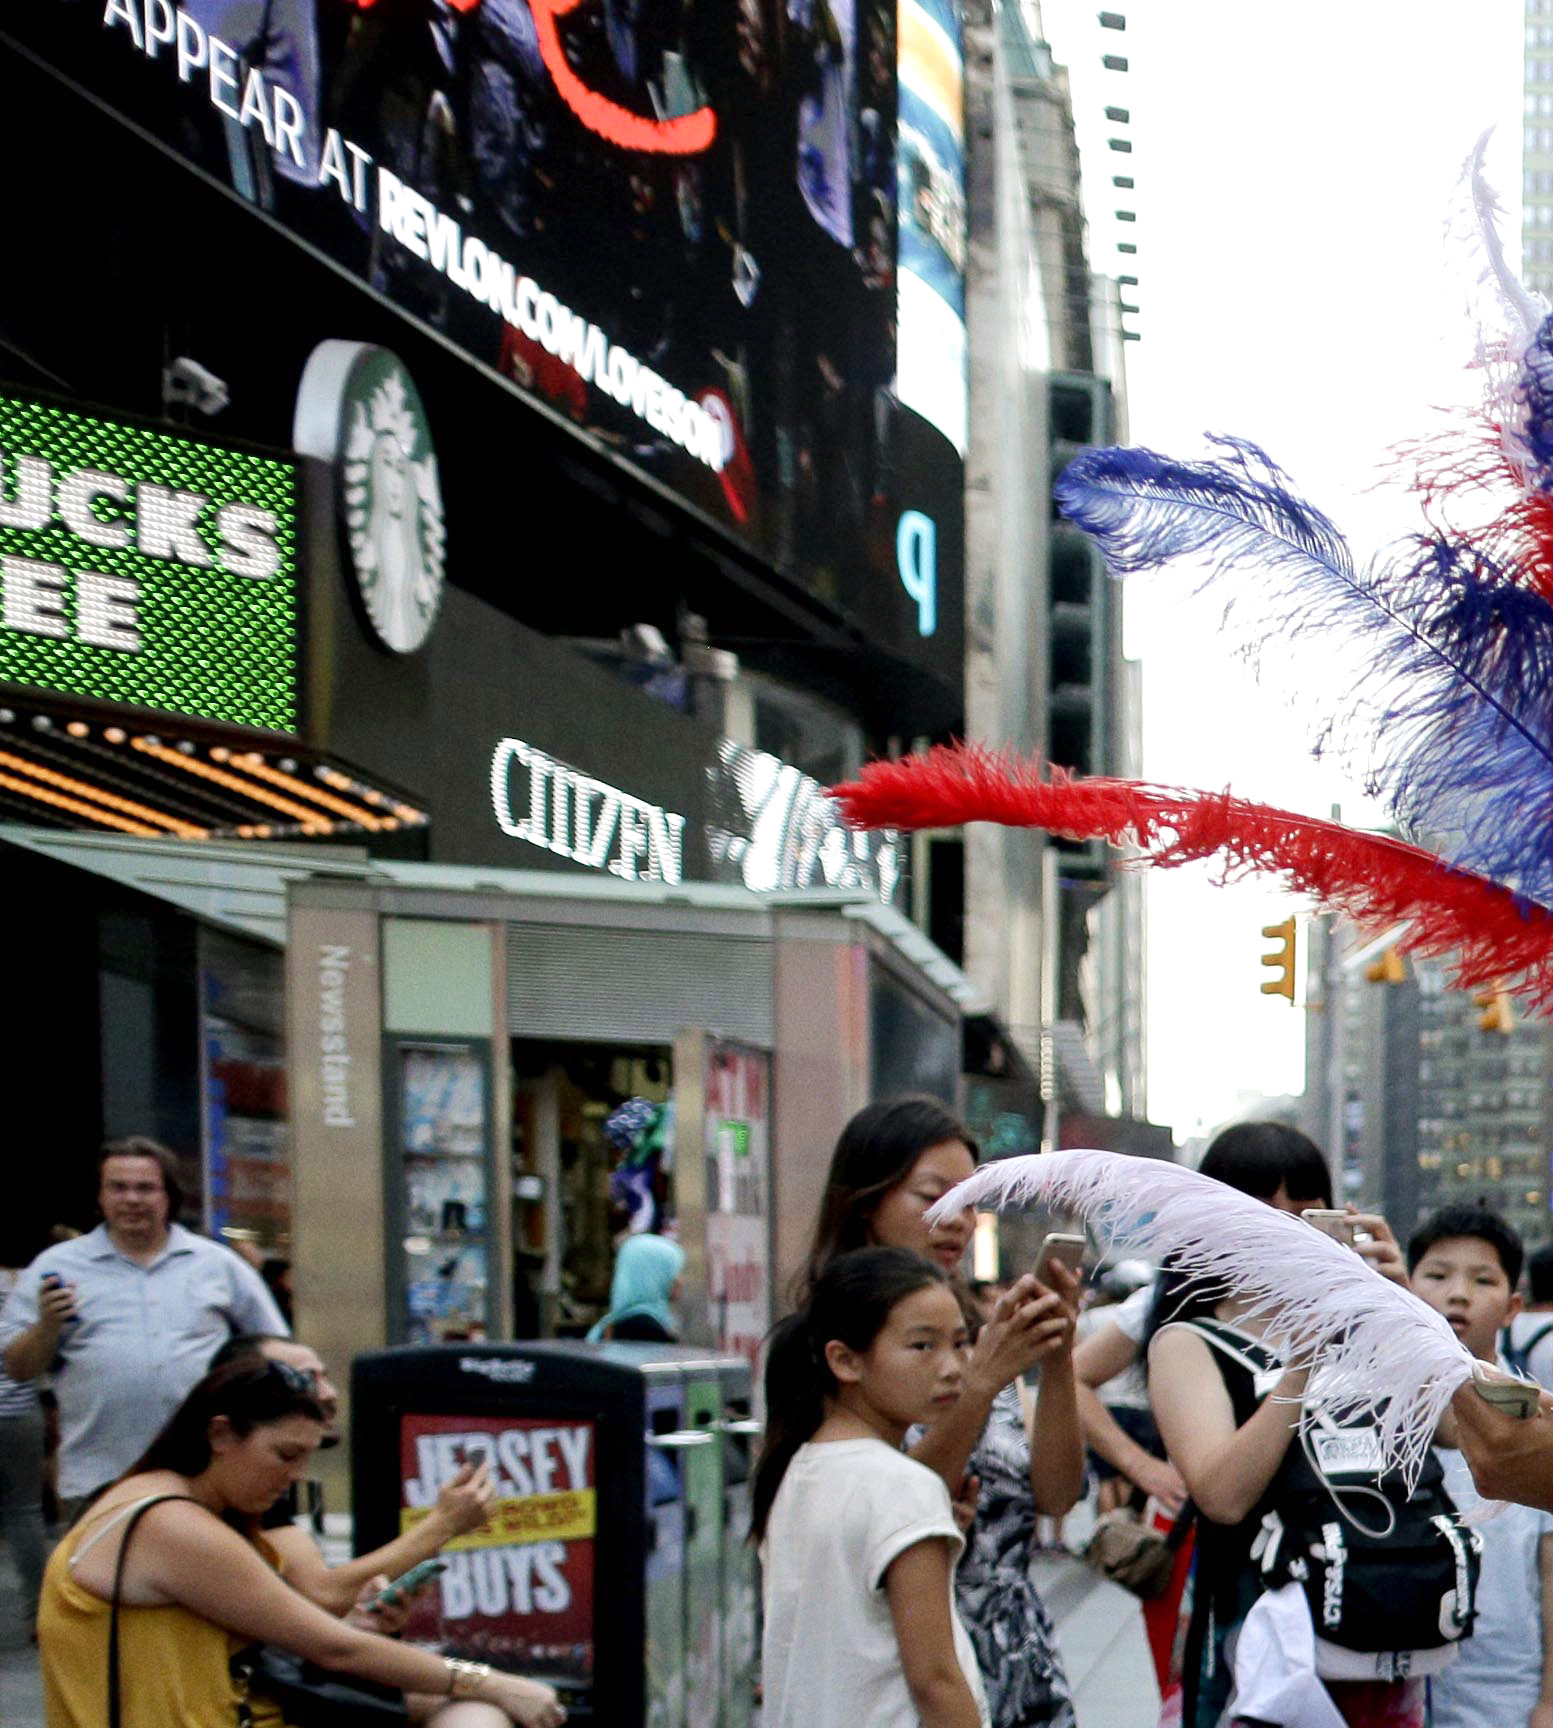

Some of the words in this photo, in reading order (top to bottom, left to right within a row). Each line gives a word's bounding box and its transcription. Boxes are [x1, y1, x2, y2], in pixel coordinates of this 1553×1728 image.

[104, 0, 306, 169] APPEAR
[318, 127, 373, 212] AT
[490, 737, 687, 887] CITIZEN
[319, 944, 357, 1128] Newsstand
